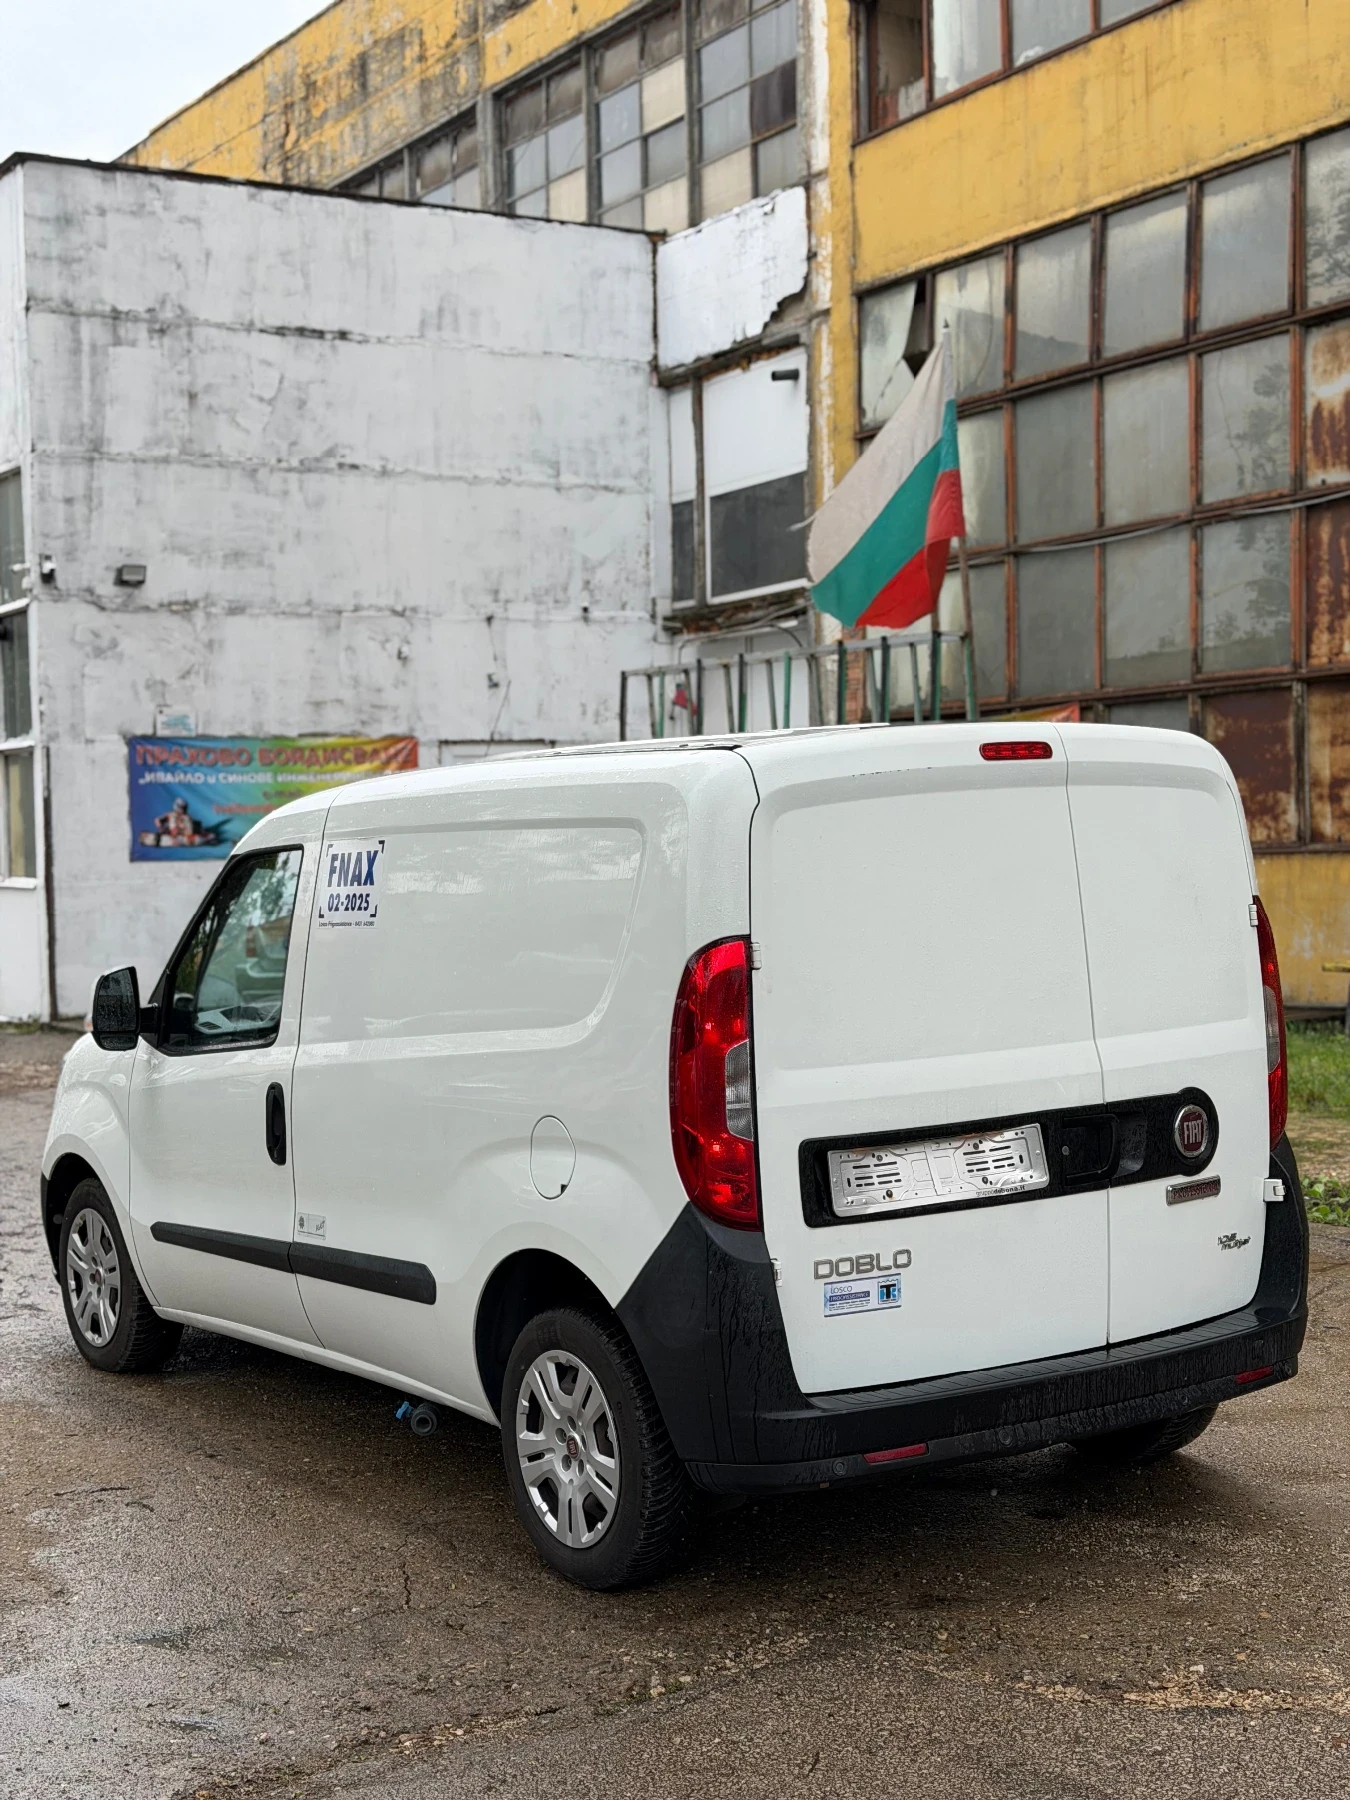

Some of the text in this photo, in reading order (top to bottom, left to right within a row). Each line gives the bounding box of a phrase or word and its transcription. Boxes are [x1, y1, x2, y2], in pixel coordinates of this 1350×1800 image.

[136, 745, 252, 767] ПРАХОВО
[327, 850, 379, 887] FNAX
[1184, 1119, 1202, 1145] FIAT
[1172, 1183, 1219, 1200] PROFESSIONAL
[813, 1248, 912, 1280] DOBLO
